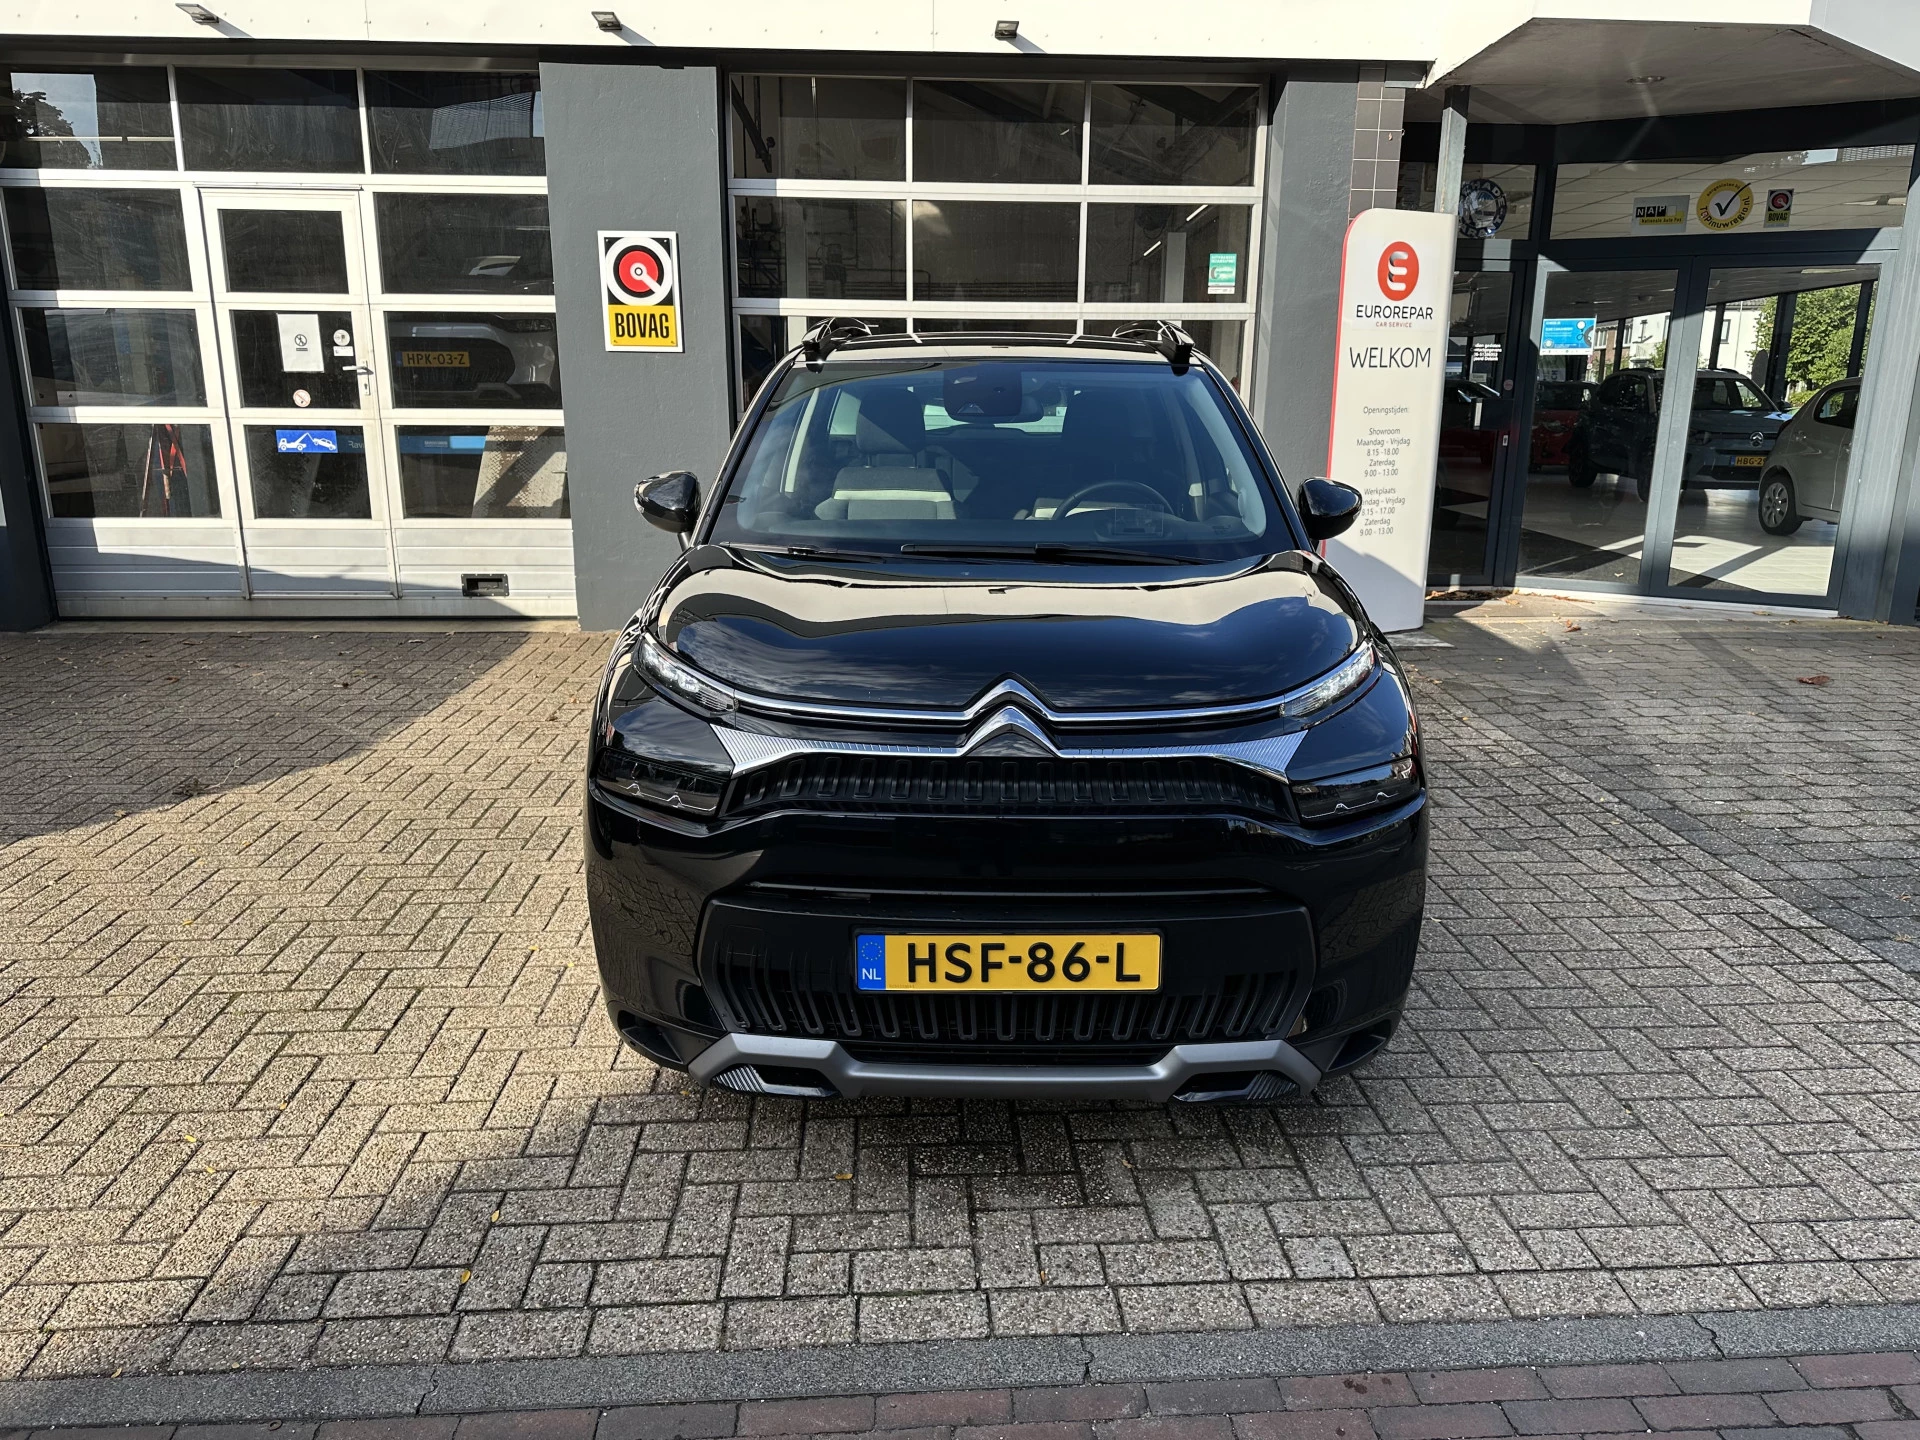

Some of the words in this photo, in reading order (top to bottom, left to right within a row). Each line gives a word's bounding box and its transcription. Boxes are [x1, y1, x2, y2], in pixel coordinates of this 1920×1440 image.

[1636, 205, 1666, 217] NAP
[1768, 211, 1788, 222] BOVAG
[1356, 304, 1434, 320] EUROREPAR
[614, 312, 670, 339] BOVAG
[406, 353, 466, 365] HPK-03-Z
[1349, 346, 1431, 368] WELKOM
[1369, 427, 1400, 435] Showroom
[1356, 438, 1384, 447] Maandag
[1390, 437, 1411, 447] Vrijdag
[1369, 458, 1396, 467] Zaterdag
[1364, 487, 1396, 496] Werkplaats
[1385, 497, 1406, 506] Vrijdag
[1380, 507, 1396, 515] 17.00
[1364, 518, 1391, 527] Zaterdag
[1378, 526, 1394, 535] 13.00
[907, 941, 1141, 983] HSF-86-L
[861, 968, 881, 981] NL
